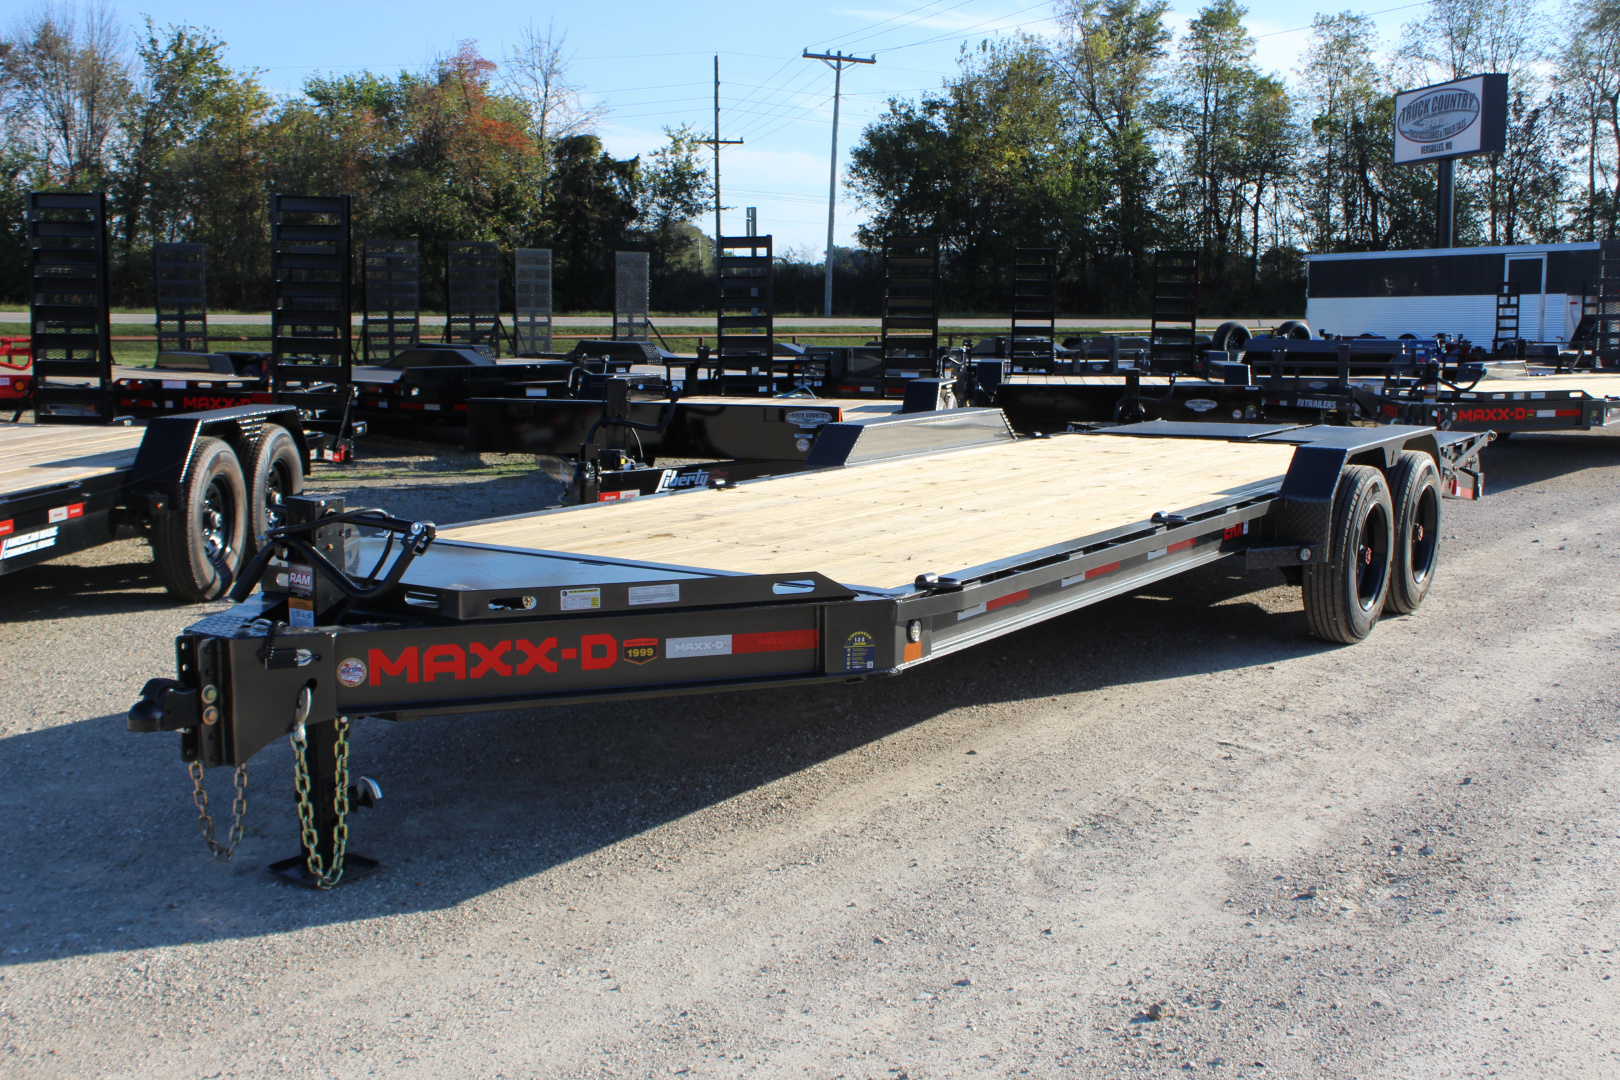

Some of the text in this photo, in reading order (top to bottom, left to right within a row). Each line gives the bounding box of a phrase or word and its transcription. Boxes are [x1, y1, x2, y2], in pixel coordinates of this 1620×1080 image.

[1401, 98, 1429, 124] TRUCK
[1431, 93, 1475, 112] COUNTRY
[1421, 141, 1452, 154] VERSAILLES MO
[1304, 399, 1337, 410] TRAILERS
[1458, 407, 1525, 422] MAXX-D
[654, 468, 710, 494] Liberty
[289, 572, 311, 586] RAM
[675, 635, 806, 652] MAXX-D MAXX-D
[368, 633, 618, 687] MAXX-D
[627, 647, 654, 658] 1999
